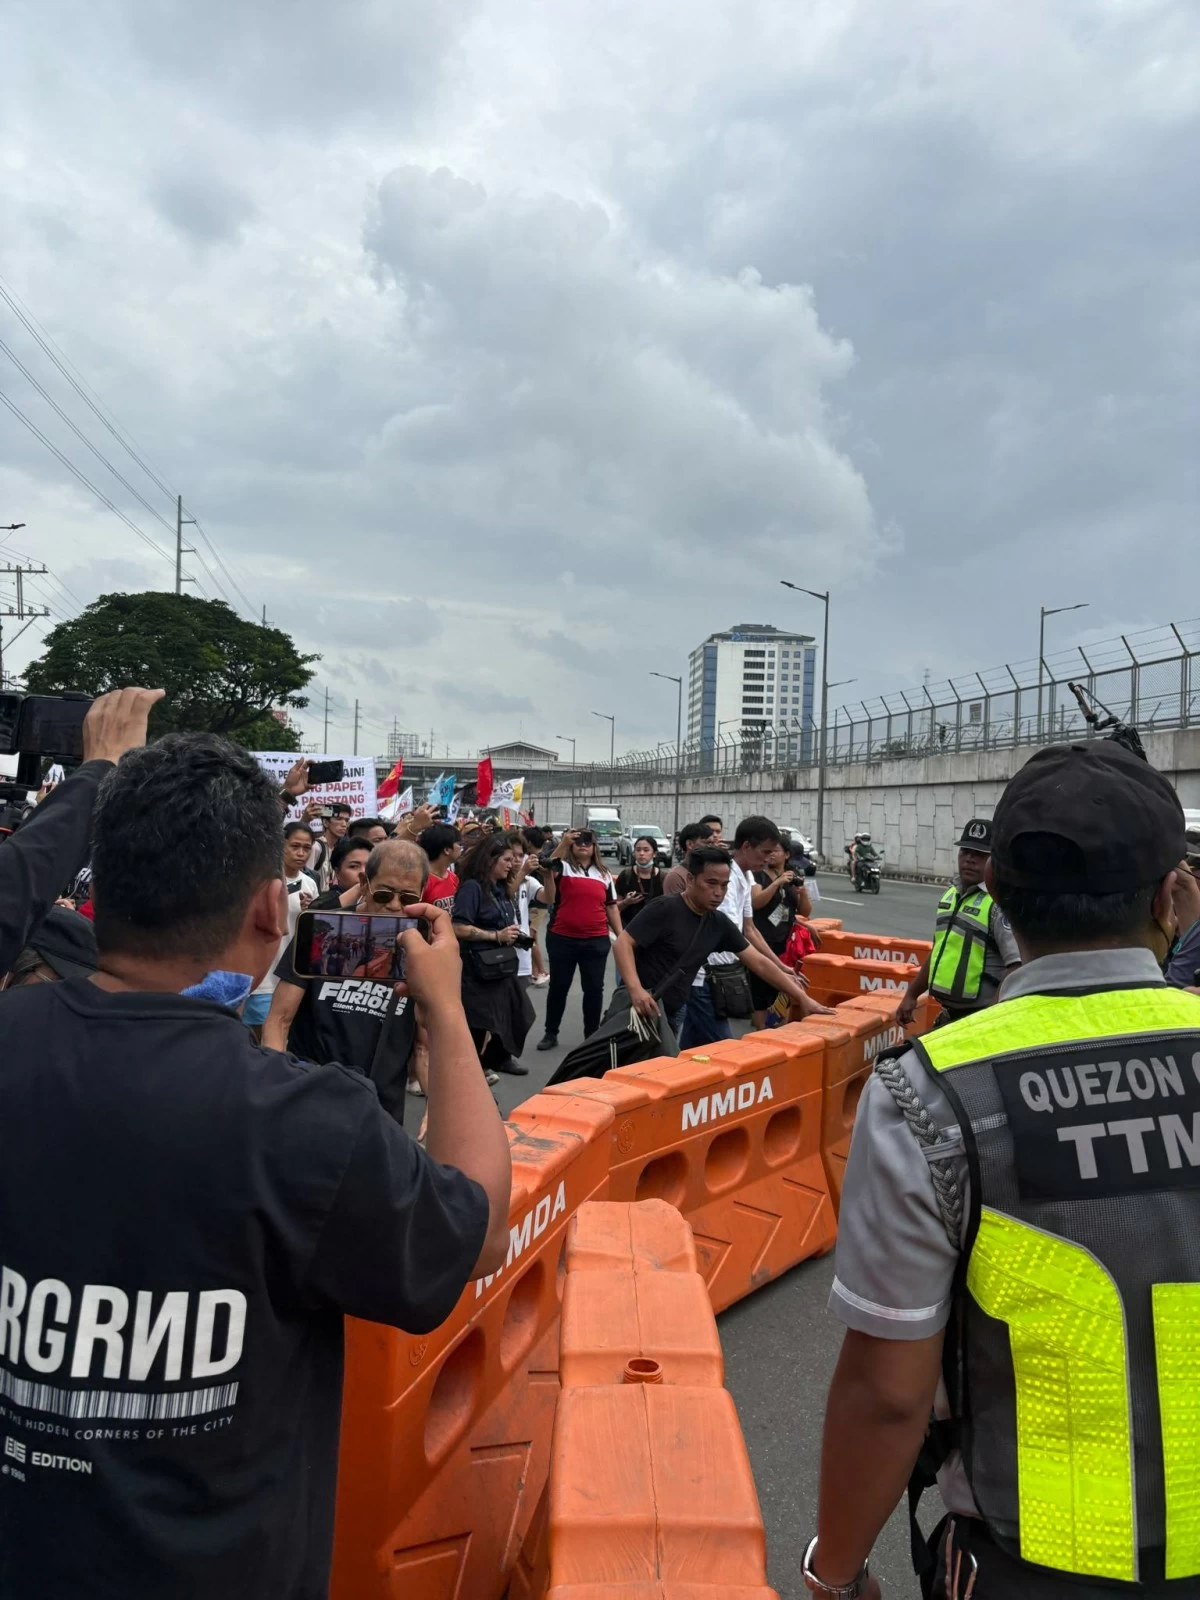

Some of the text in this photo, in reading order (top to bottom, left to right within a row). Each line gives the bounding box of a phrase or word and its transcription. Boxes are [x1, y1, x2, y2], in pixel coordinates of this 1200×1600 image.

[343, 767, 365, 778] AIN!
[326, 781, 364, 792] PAPET,
[854, 946, 920, 966] MMDA
[860, 975, 909, 992] MM
[863, 1026, 904, 1061] MMDA
[1019, 1055, 1185, 1113] QUEZON
[681, 1076, 774, 1131] MMDA
[25, 1419, 69, 1437] HIDDEN
[75, 1429, 139, 1440] CORNERS
[146, 1429, 164, 1440] OF
[172, 1425, 197, 1437] THE
[204, 1414, 234, 1432] CITY
[31, 1451, 93, 1474] EDITION
